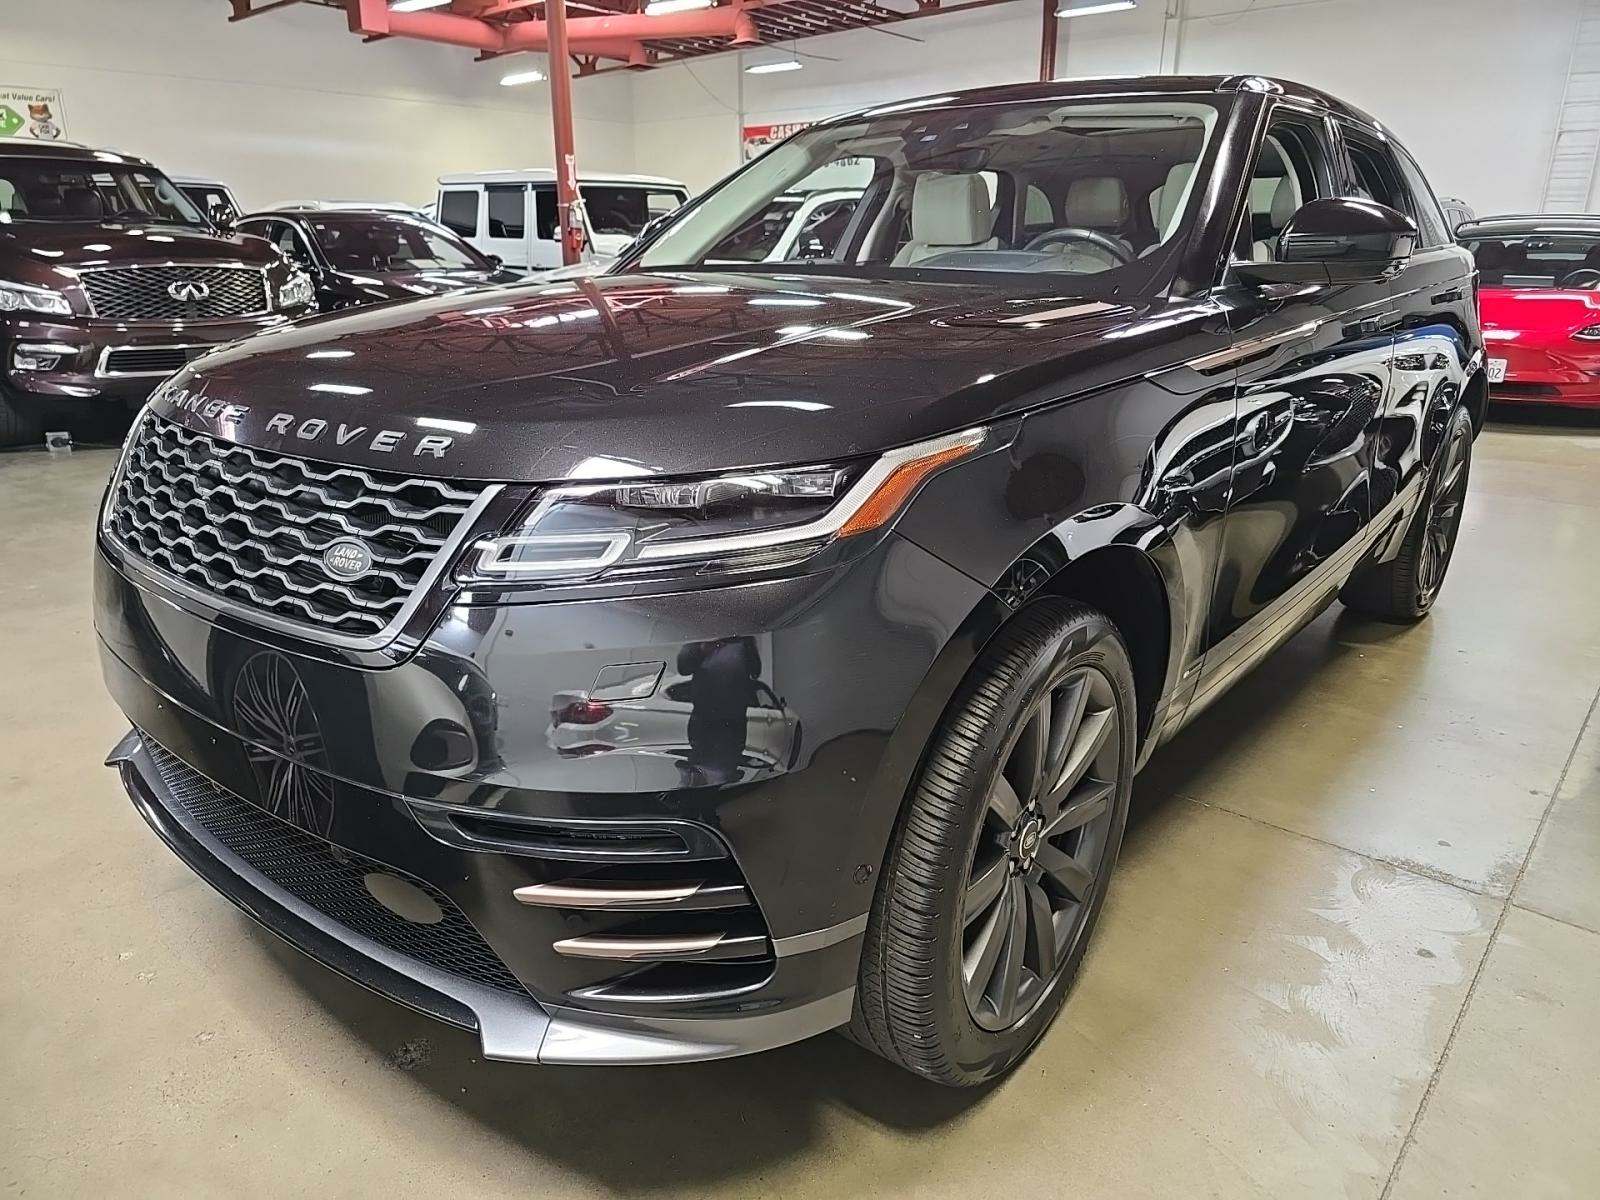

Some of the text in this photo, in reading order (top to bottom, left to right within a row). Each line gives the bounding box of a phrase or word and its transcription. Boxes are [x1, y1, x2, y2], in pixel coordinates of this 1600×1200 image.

[12, 93, 33, 101] Value
[265, 412, 453, 459] ROVER
[334, 546, 358, 559] LAND
[333, 556, 362, 571] ROVER
